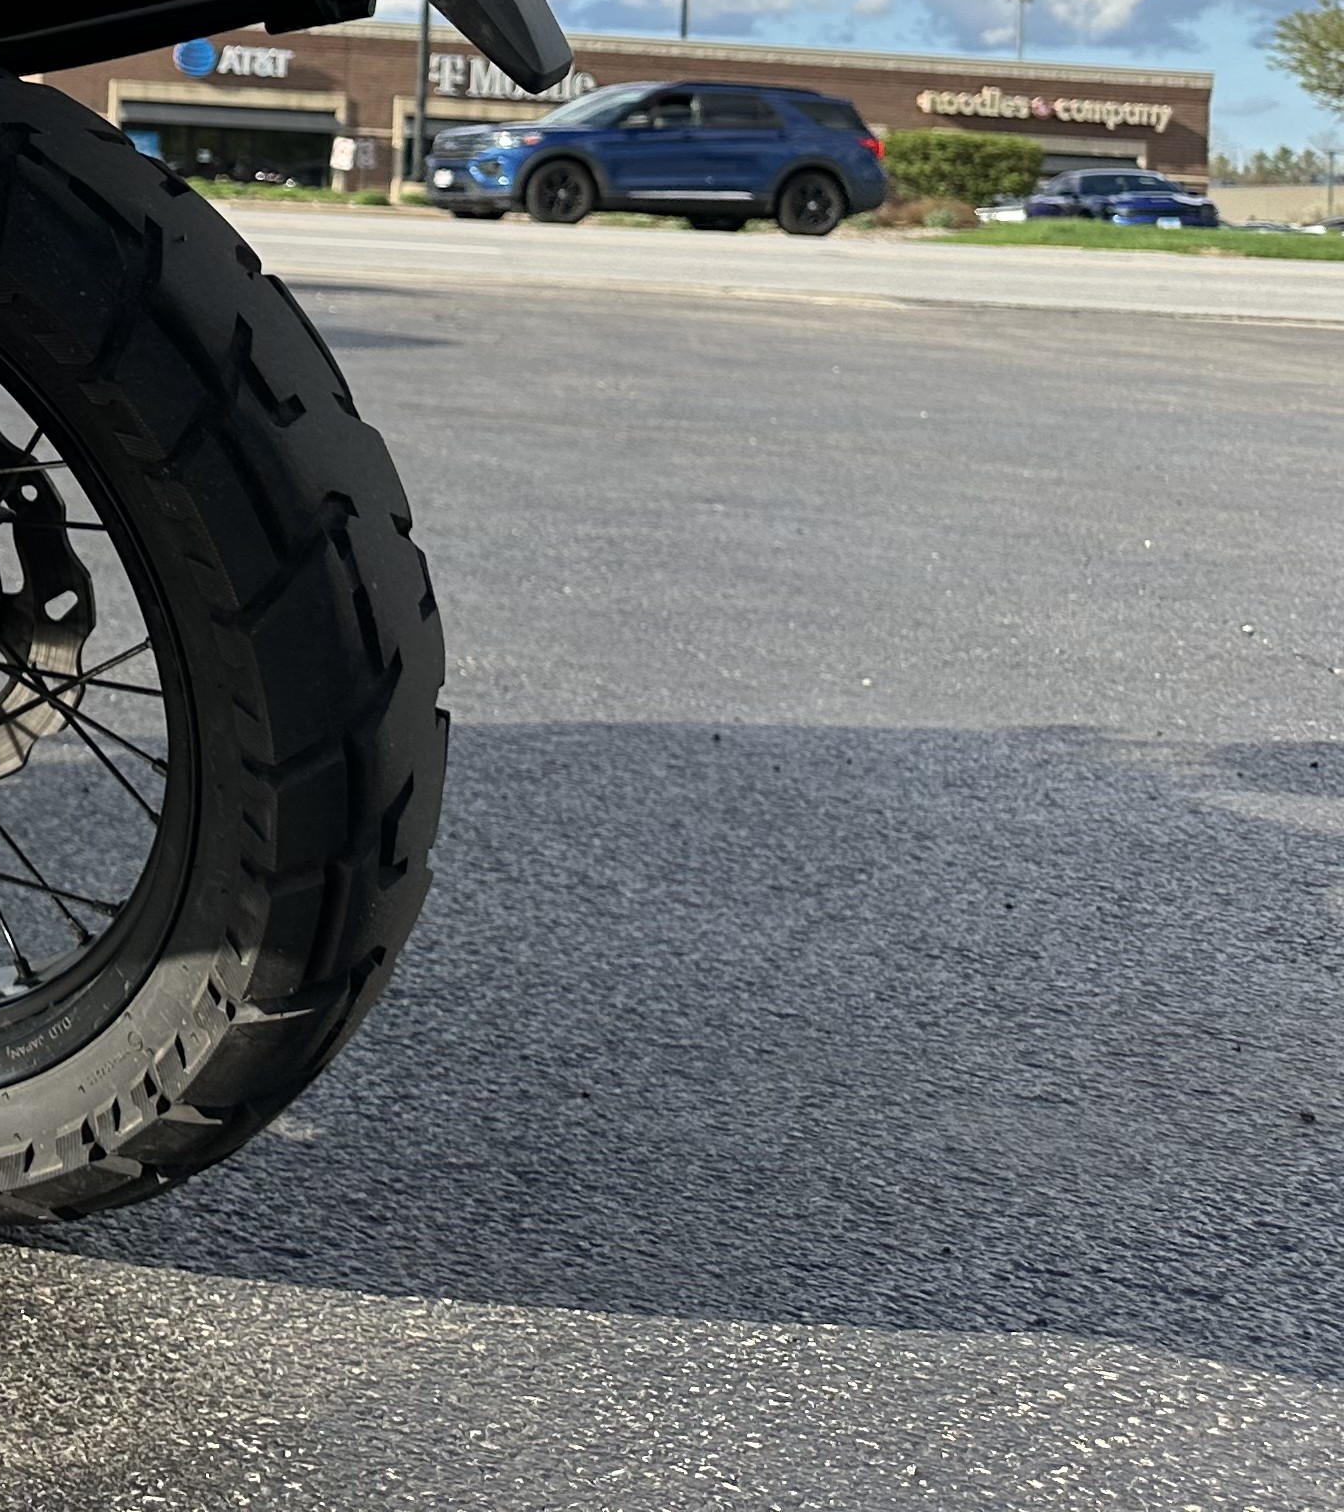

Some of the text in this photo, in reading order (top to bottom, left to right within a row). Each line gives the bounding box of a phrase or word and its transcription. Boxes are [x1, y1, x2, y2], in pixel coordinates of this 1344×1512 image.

[216, 44, 296, 78] AT&T
[916, 85, 1031, 119] noodles
[1053, 98, 1173, 133] company
